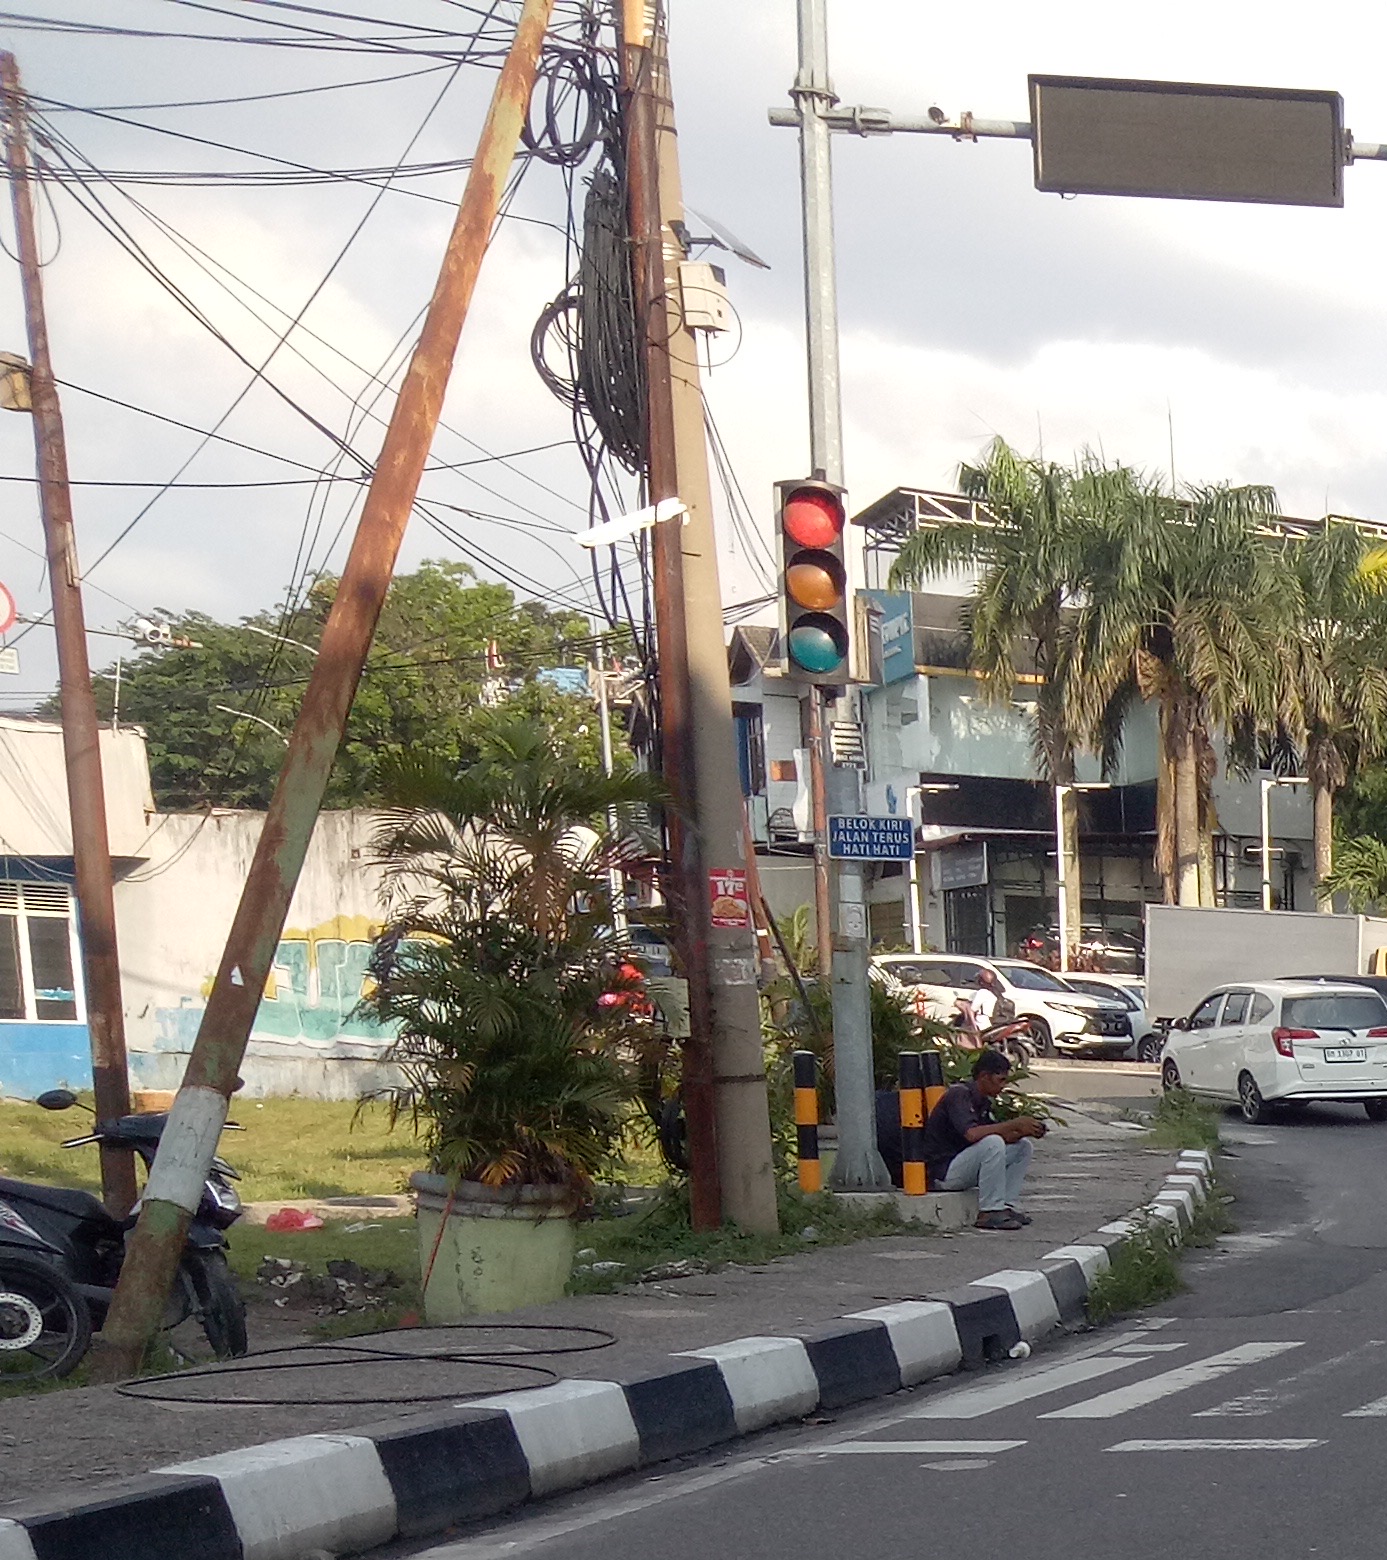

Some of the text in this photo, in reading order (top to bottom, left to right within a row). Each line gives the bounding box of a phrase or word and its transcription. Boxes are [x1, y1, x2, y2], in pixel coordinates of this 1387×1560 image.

[838, 818, 902, 832] BELOK KIRI
[832, 831, 910, 844] JALAN TERUS
[843, 843, 900, 856] HATI HATI
